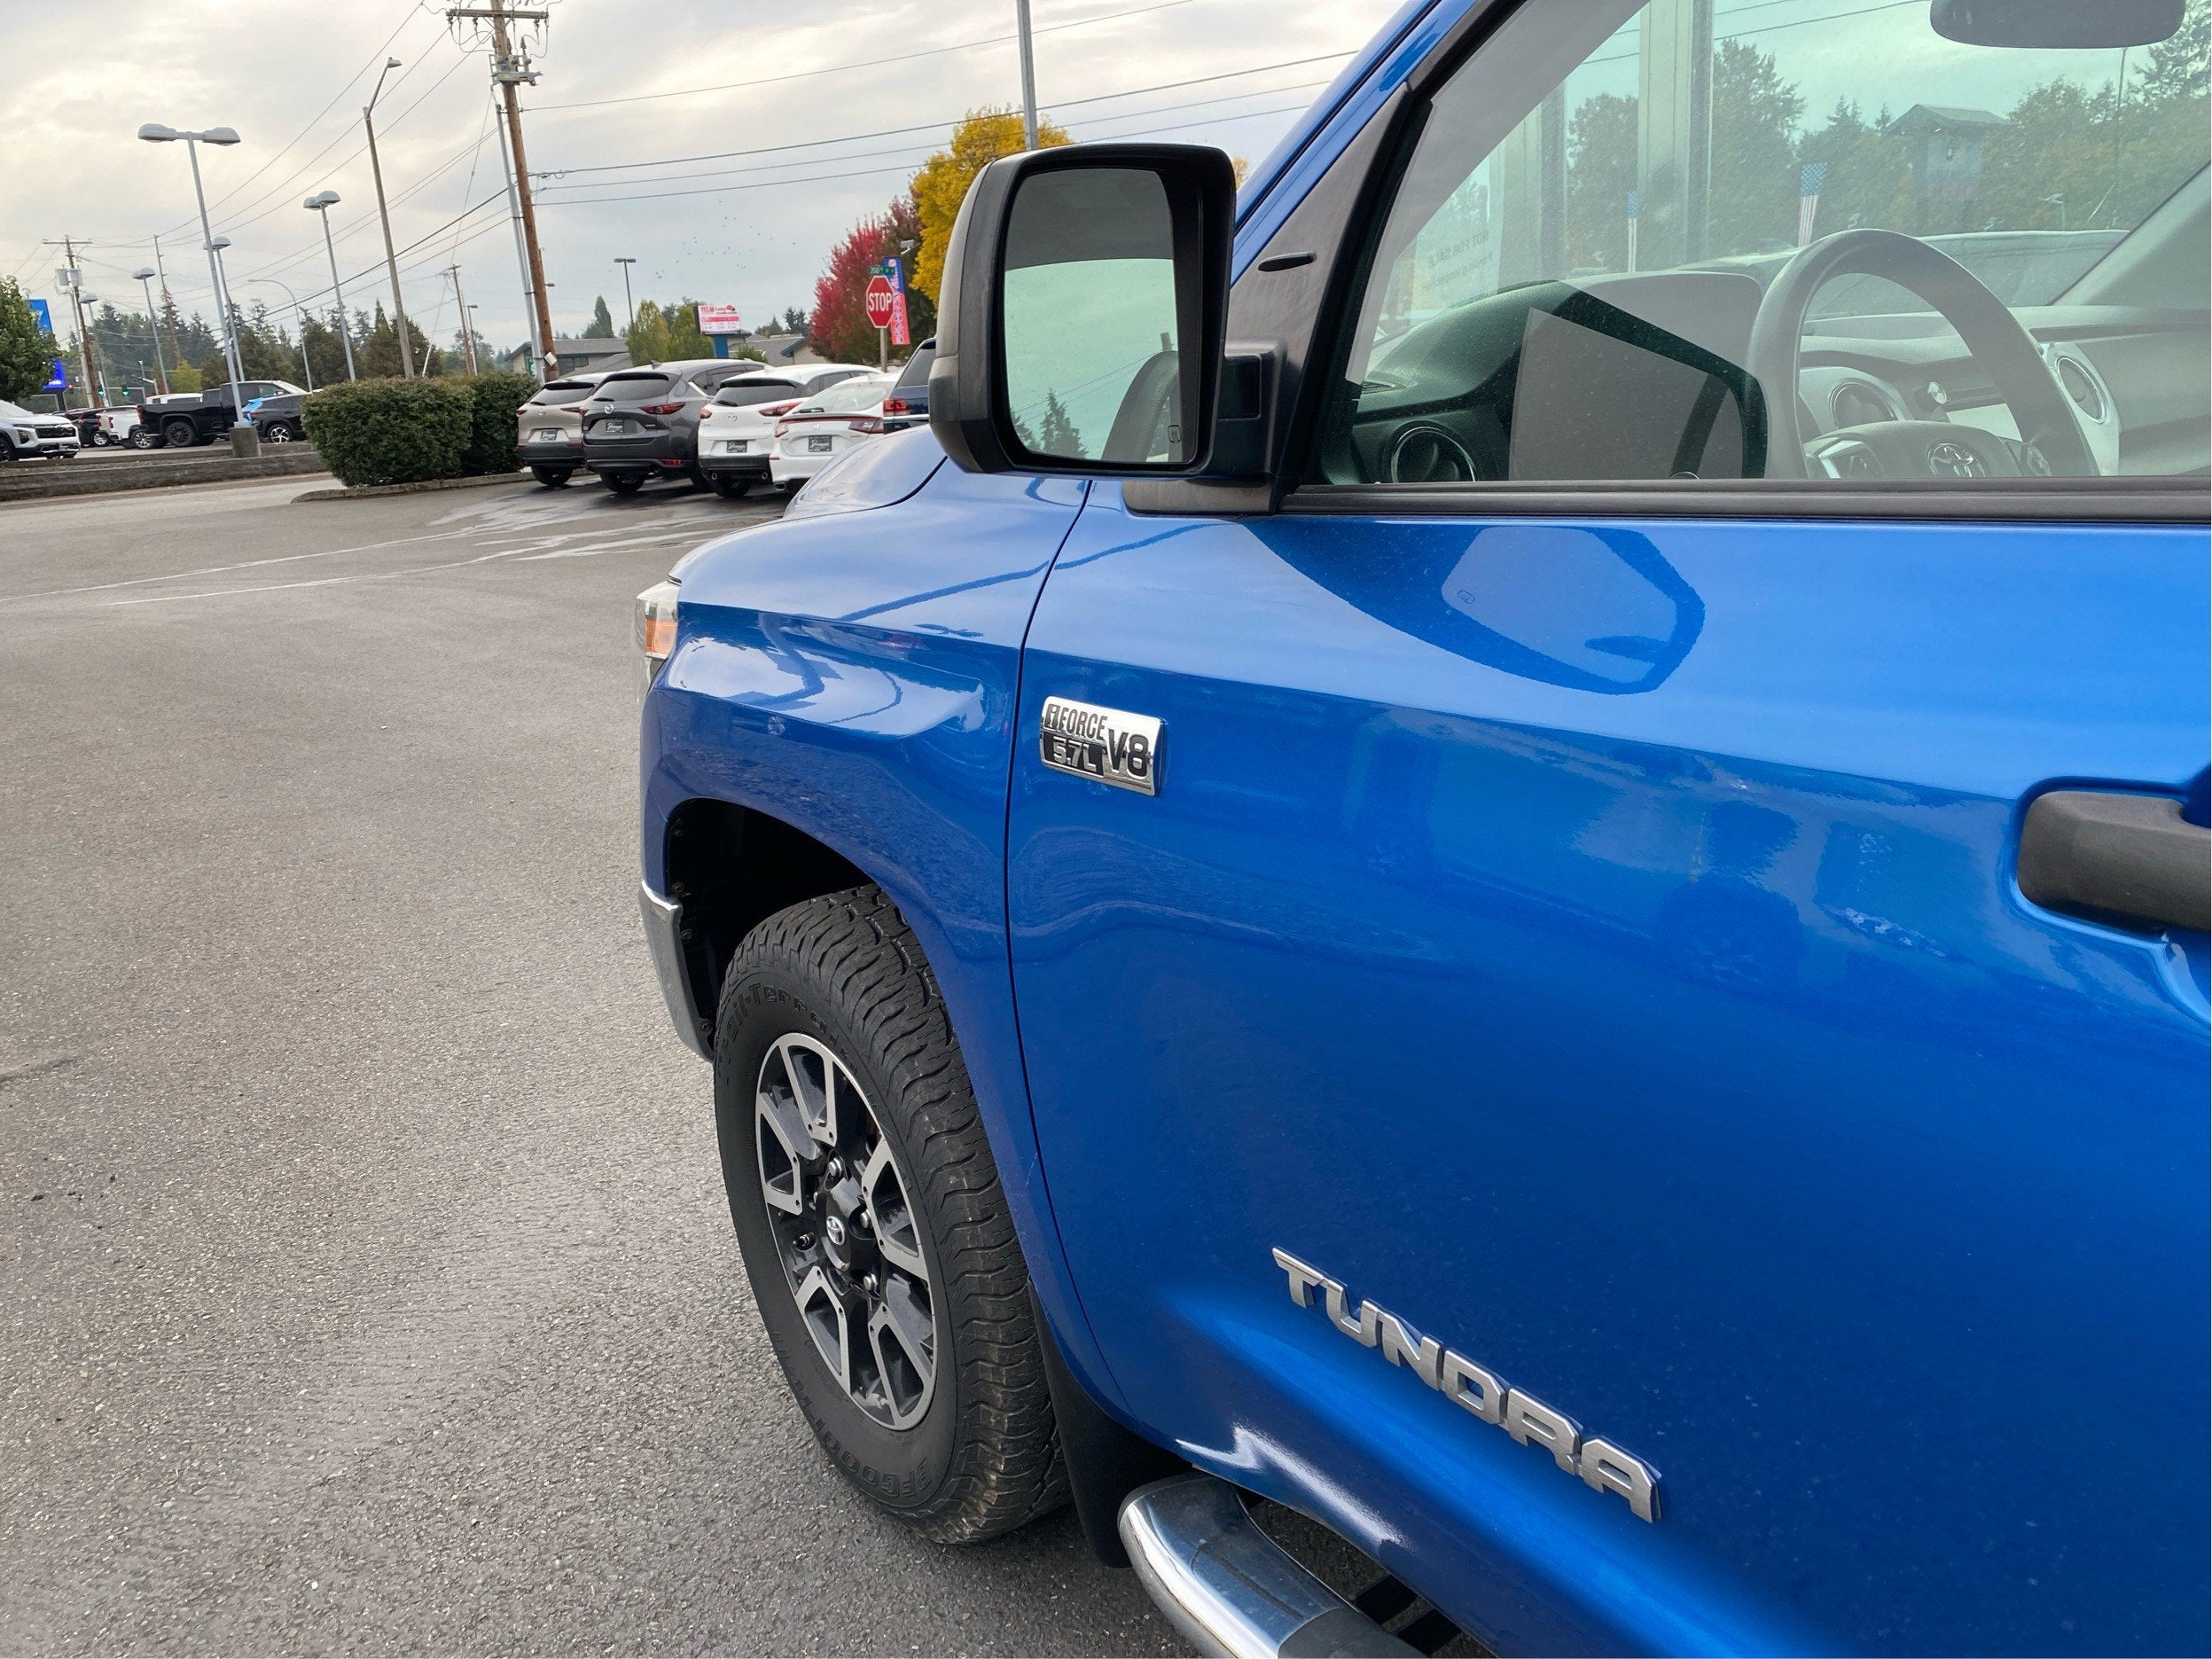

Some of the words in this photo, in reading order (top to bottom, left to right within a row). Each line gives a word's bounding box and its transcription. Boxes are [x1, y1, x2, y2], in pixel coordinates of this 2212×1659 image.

[869, 292, 893, 312] STOP
[1053, 736, 1097, 772] 5.7L
[1108, 728, 1150, 779] V8
[1272, 1247, 1655, 1524] TUNDRA
